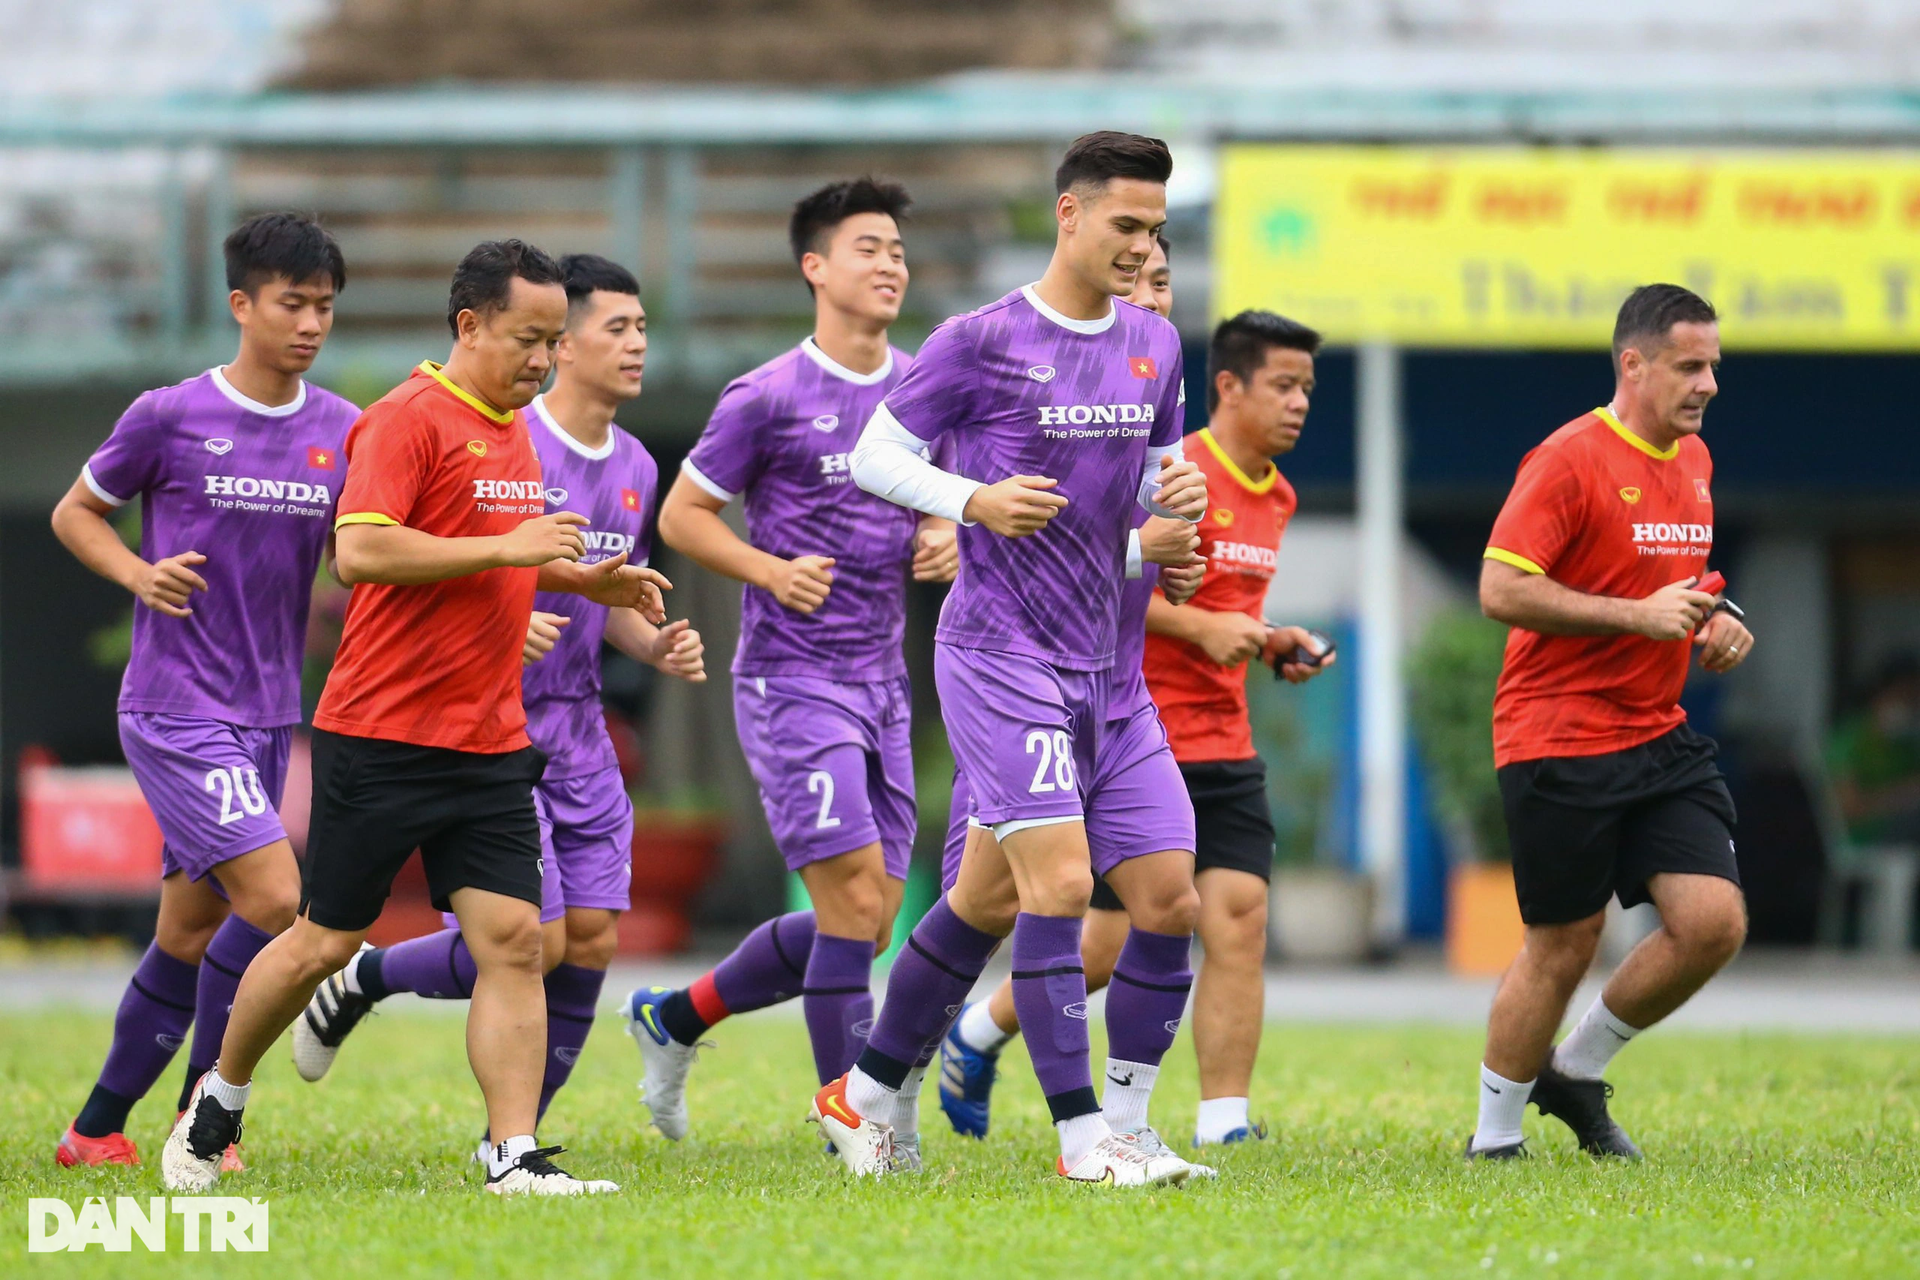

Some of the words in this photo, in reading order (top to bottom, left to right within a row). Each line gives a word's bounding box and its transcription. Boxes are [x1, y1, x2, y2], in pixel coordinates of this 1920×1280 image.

[1038, 404, 1155, 425] HONDA
[1044, 429, 1067, 439] The
[1070, 429, 1105, 438] Power
[1107, 427, 1119, 437] of
[204, 475, 331, 504] HONDA
[210, 498, 234, 508] The
[236, 500, 271, 511] Power
[273, 503, 285, 513] of
[476, 502, 495, 512] The
[496, 503, 517, 513] Power
[518, 504, 529, 514] of
[529, 504, 544, 514] Drea
[580, 531, 635, 553] NDA
[1632, 523, 1713, 543] HONDA
[1212, 540, 1277, 567] HOND
[1636, 545, 1656, 556] The
[1656, 545, 1679, 556] Power
[1680, 545, 1690, 555] of
[1025, 729, 1074, 793] 28
[205, 766, 266, 826] 20
[808, 770, 841, 829] 2
